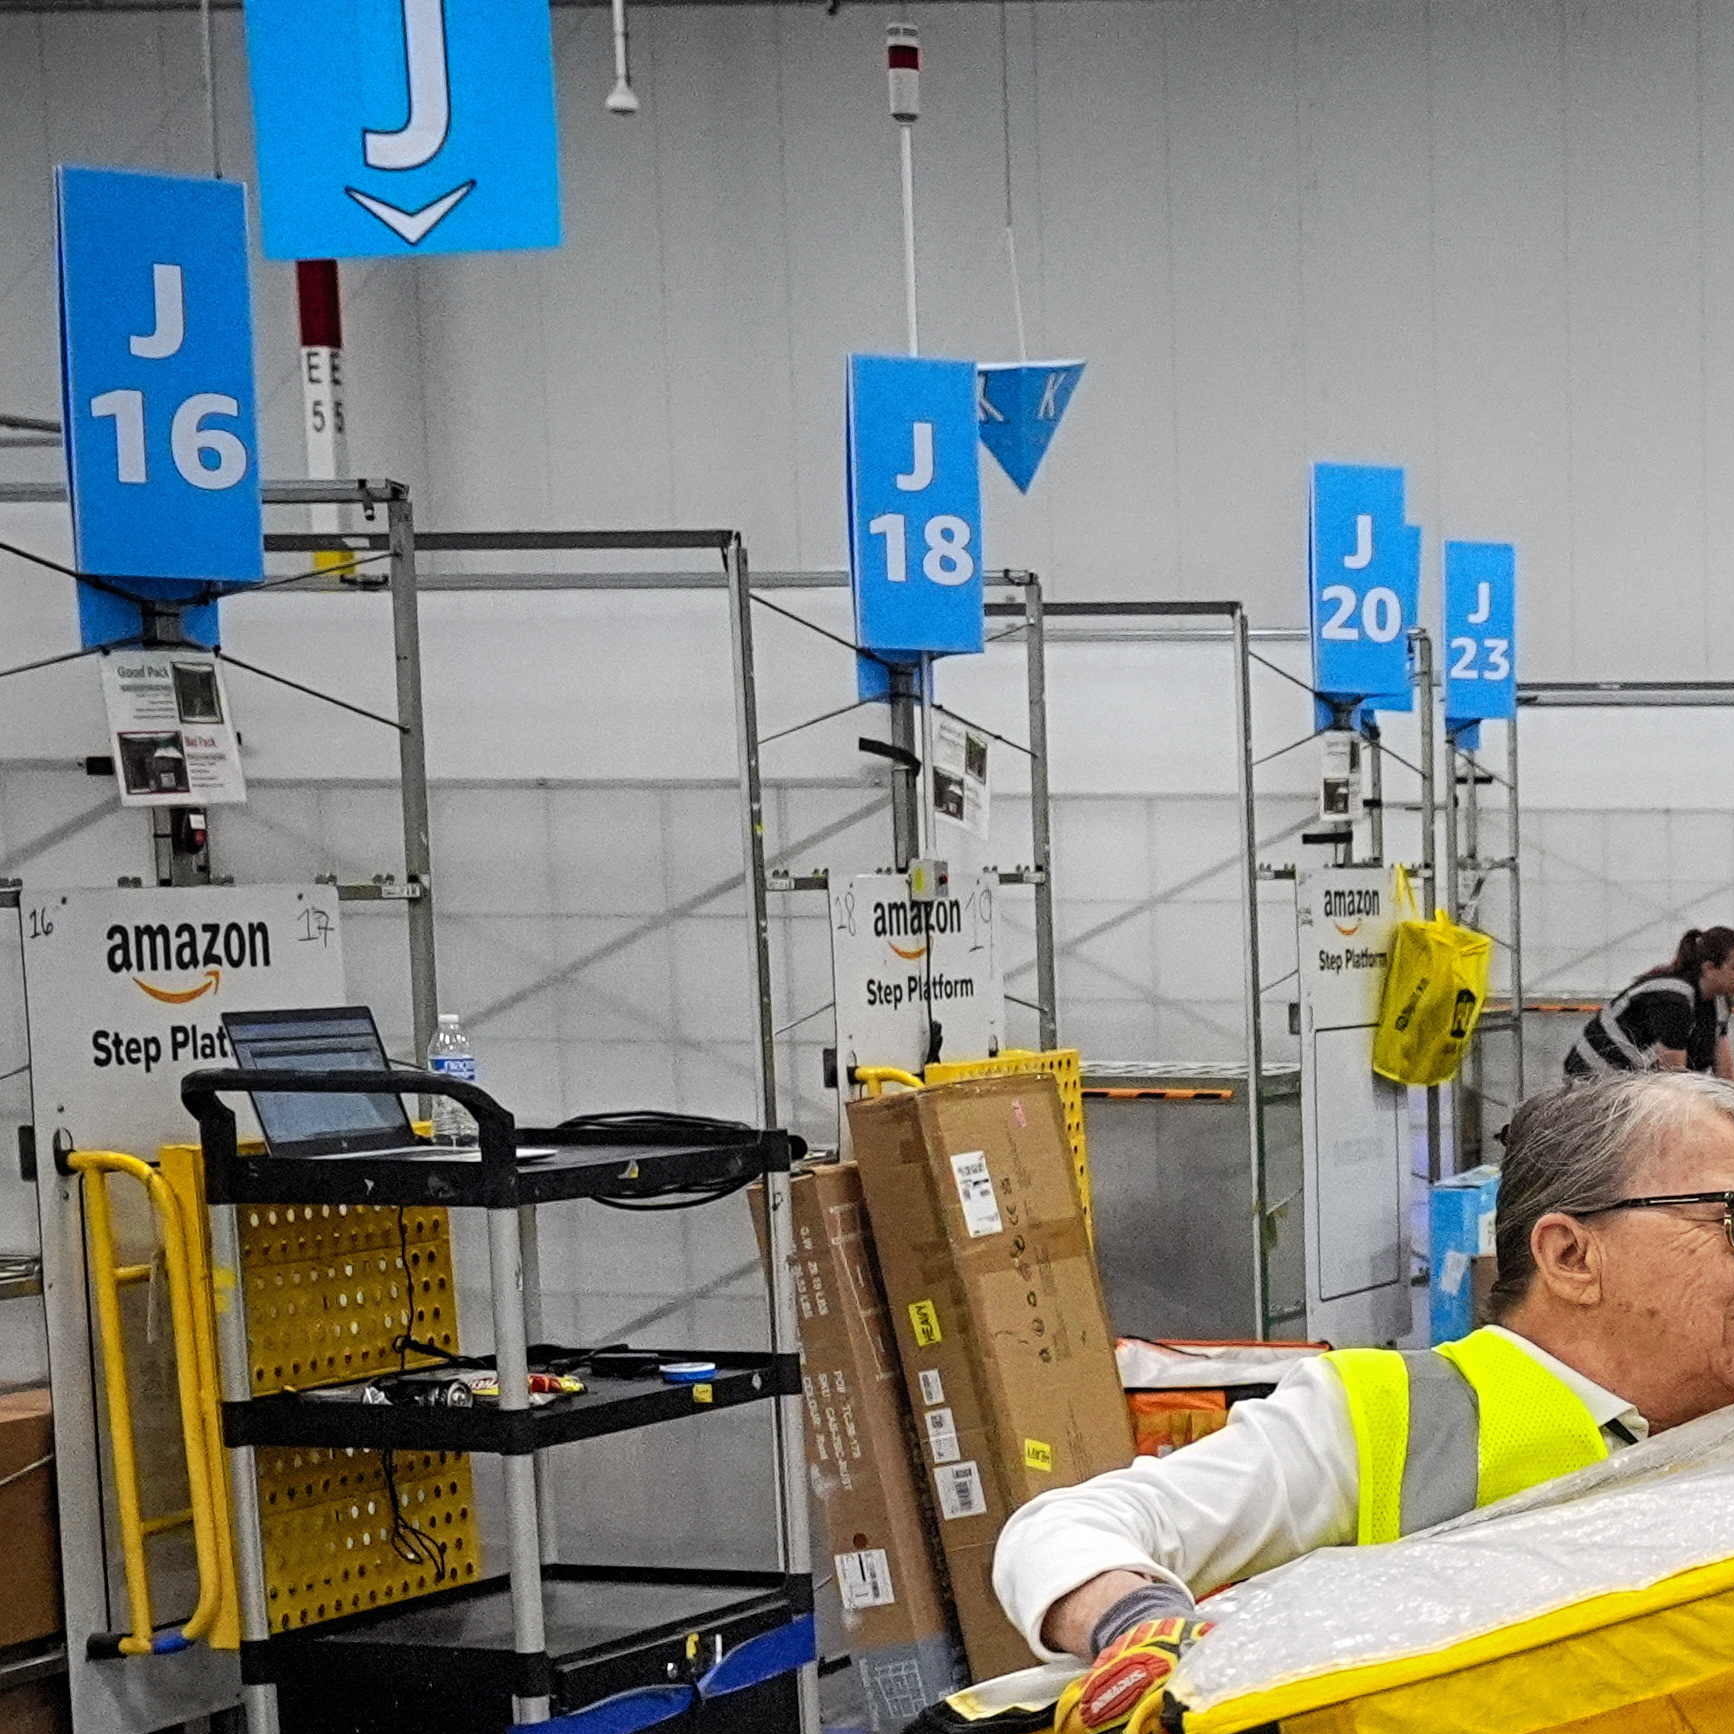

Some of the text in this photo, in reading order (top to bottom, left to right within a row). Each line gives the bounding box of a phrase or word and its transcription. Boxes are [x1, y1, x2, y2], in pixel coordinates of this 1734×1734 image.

[361, 0, 450, 172] J
[129, 261, 186, 360] J
[90, 389, 249, 491] 16
[895, 420, 935, 492] J
[868, 512, 975, 587] 18
[1343, 514, 1373, 570] J
[1320, 584, 1402, 644] 20
[1466, 581, 1490, 625] J
[117, 665, 145, 679] Good
[1449, 636, 1511, 681] 23
[28, 907, 54, 939] 16
[872, 899, 962, 938] amazon
[1323, 888, 1380, 918] amazon
[105, 920, 271, 974] amazon
[297, 906, 335, 949] 17
[1318, 949, 1342, 975] Step
[866, 972, 974, 1011] Step Platform
[91, 1024, 234, 1074] Step Plat
